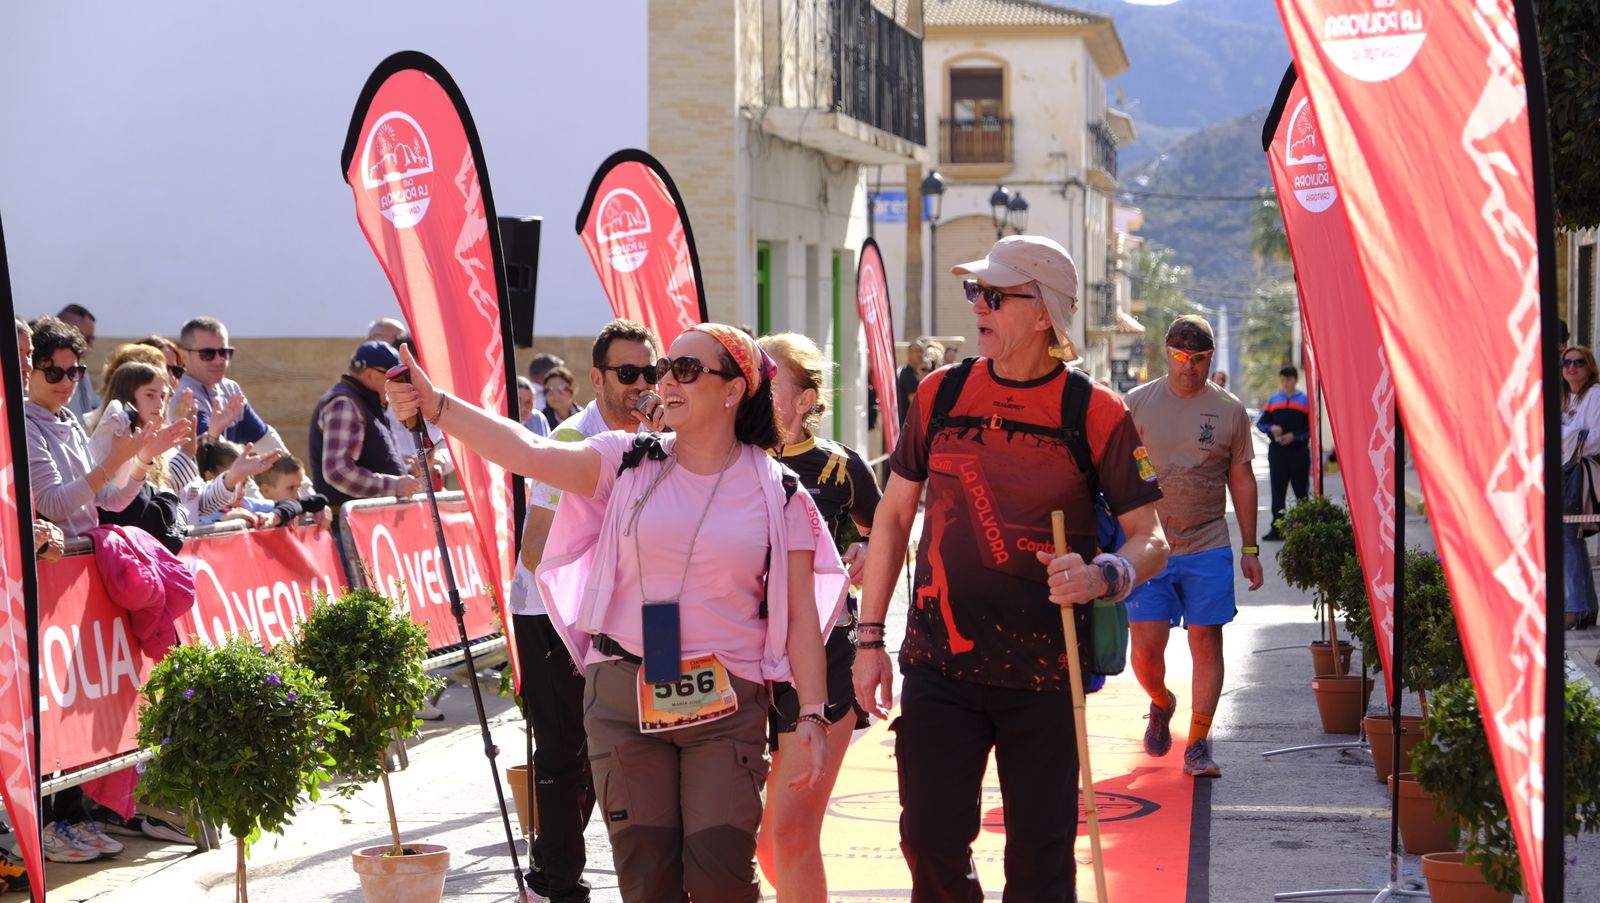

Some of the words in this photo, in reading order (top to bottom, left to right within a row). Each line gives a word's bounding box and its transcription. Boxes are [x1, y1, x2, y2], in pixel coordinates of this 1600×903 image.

[960, 461, 978, 484] LA
[969, 485, 1010, 565] POLVORA
[654, 670, 715, 699] 566
